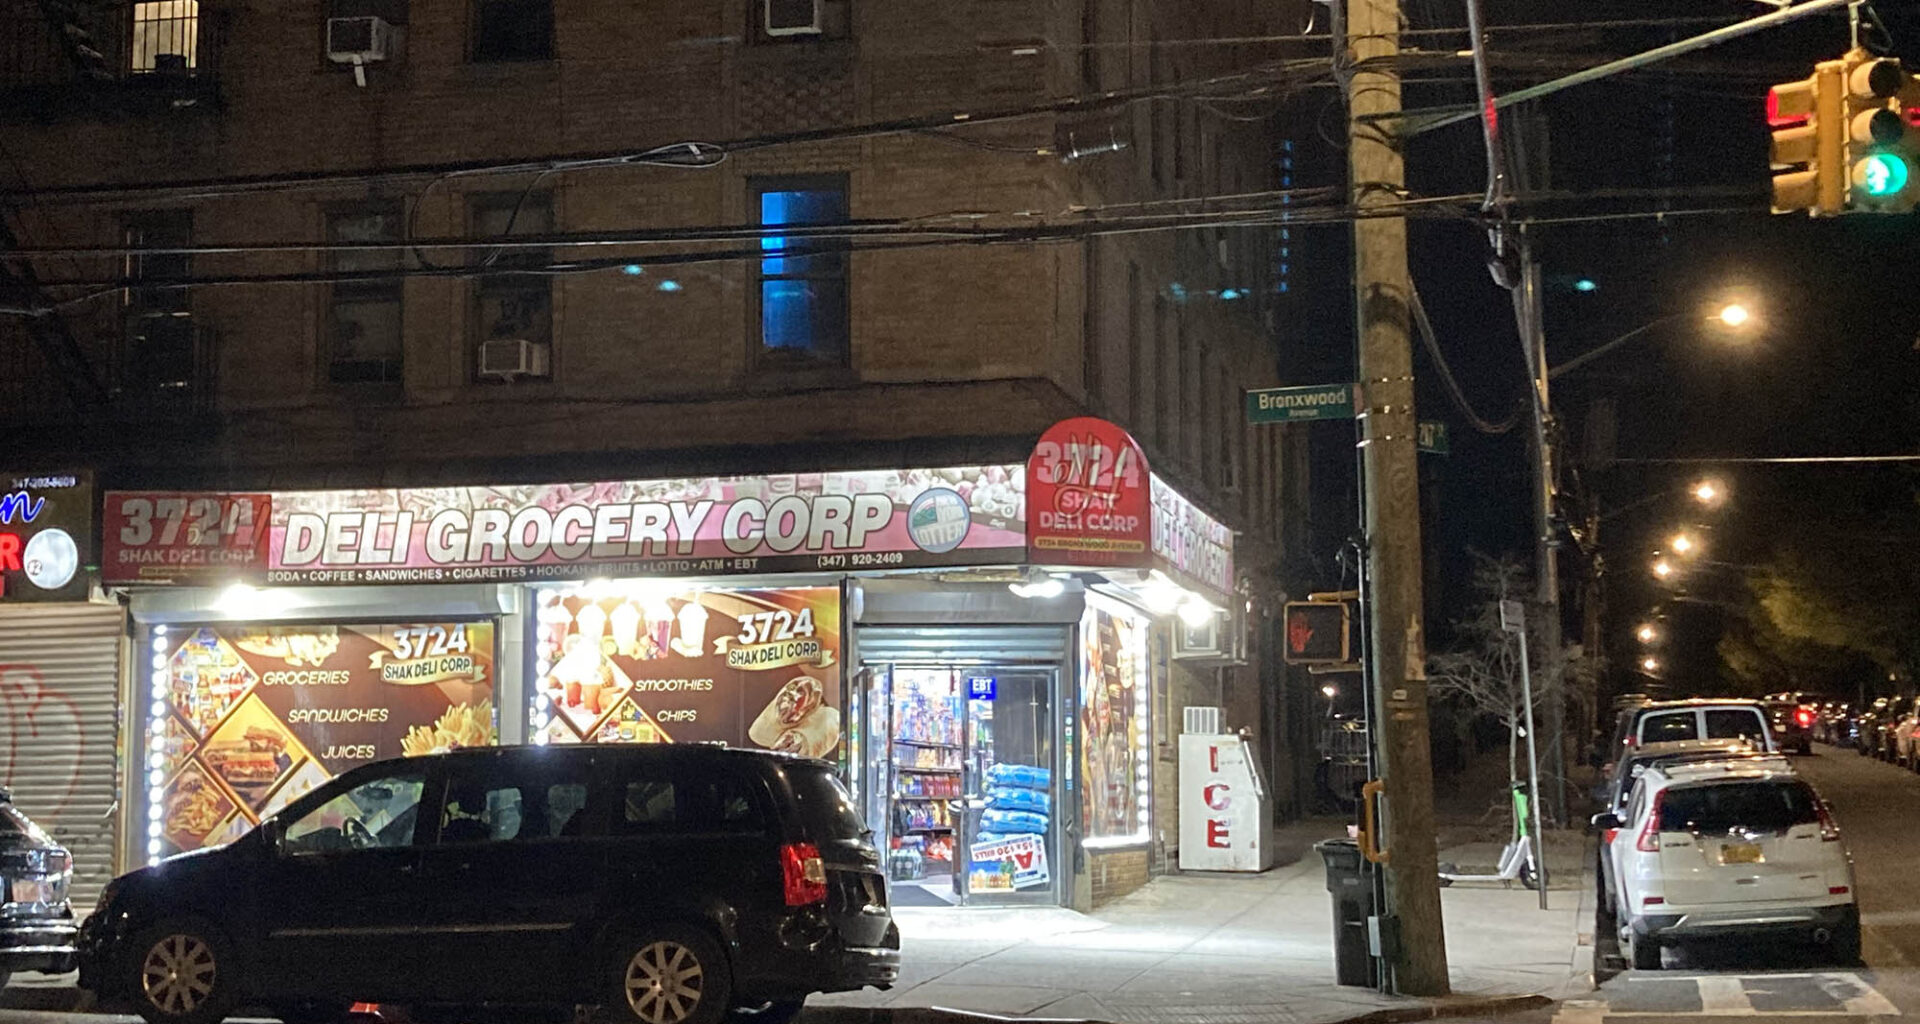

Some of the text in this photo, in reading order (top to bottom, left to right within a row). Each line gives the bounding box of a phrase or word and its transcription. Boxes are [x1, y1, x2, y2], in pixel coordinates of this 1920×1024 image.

[1258, 389, 1346, 409] Bronxwood
[1036, 441, 1139, 488] 3724
[120, 498, 254, 546] 3724
[281, 510, 414, 566] DELI
[424, 500, 715, 564] GROCERY
[721, 492, 894, 554] CORP
[1040, 511, 1139, 532] DELI CORP
[119, 549, 165, 563] SHAK
[169, 549, 206, 563] DELI
[267, 570, 300, 583] SODA
[309, 569, 355, 582] COFFEE
[365, 567, 442, 580] SANDWICHES
[453, 566, 527, 579] CIGARETTES
[536, 563, 589, 576] HOOKAH
[650, 560, 690, 572] LOTTO
[699, 558, 725, 570] ATM
[734, 557, 758, 569] EBT
[817, 555, 846, 568] (347)
[852, 553, 903, 565] 920-2409
[738, 608, 814, 644] 3724
[393, 623, 468, 659] 3724
[729, 649, 758, 665] SHAK
[760, 645, 784, 662] DELI
[262, 670, 350, 686] GROCERIES
[385, 663, 413, 680] SHAK
[414, 660, 438, 678] DELI
[634, 679, 713, 692] SMOOTHIES
[972, 679, 993, 691] EBT
[287, 708, 389, 724] SANDWICHES
[656, 709, 697, 722] CHIPS
[321, 745, 376, 759] JUICES
[1203, 746, 1231, 848] ICE
[974, 849, 996, 860] BILLS
